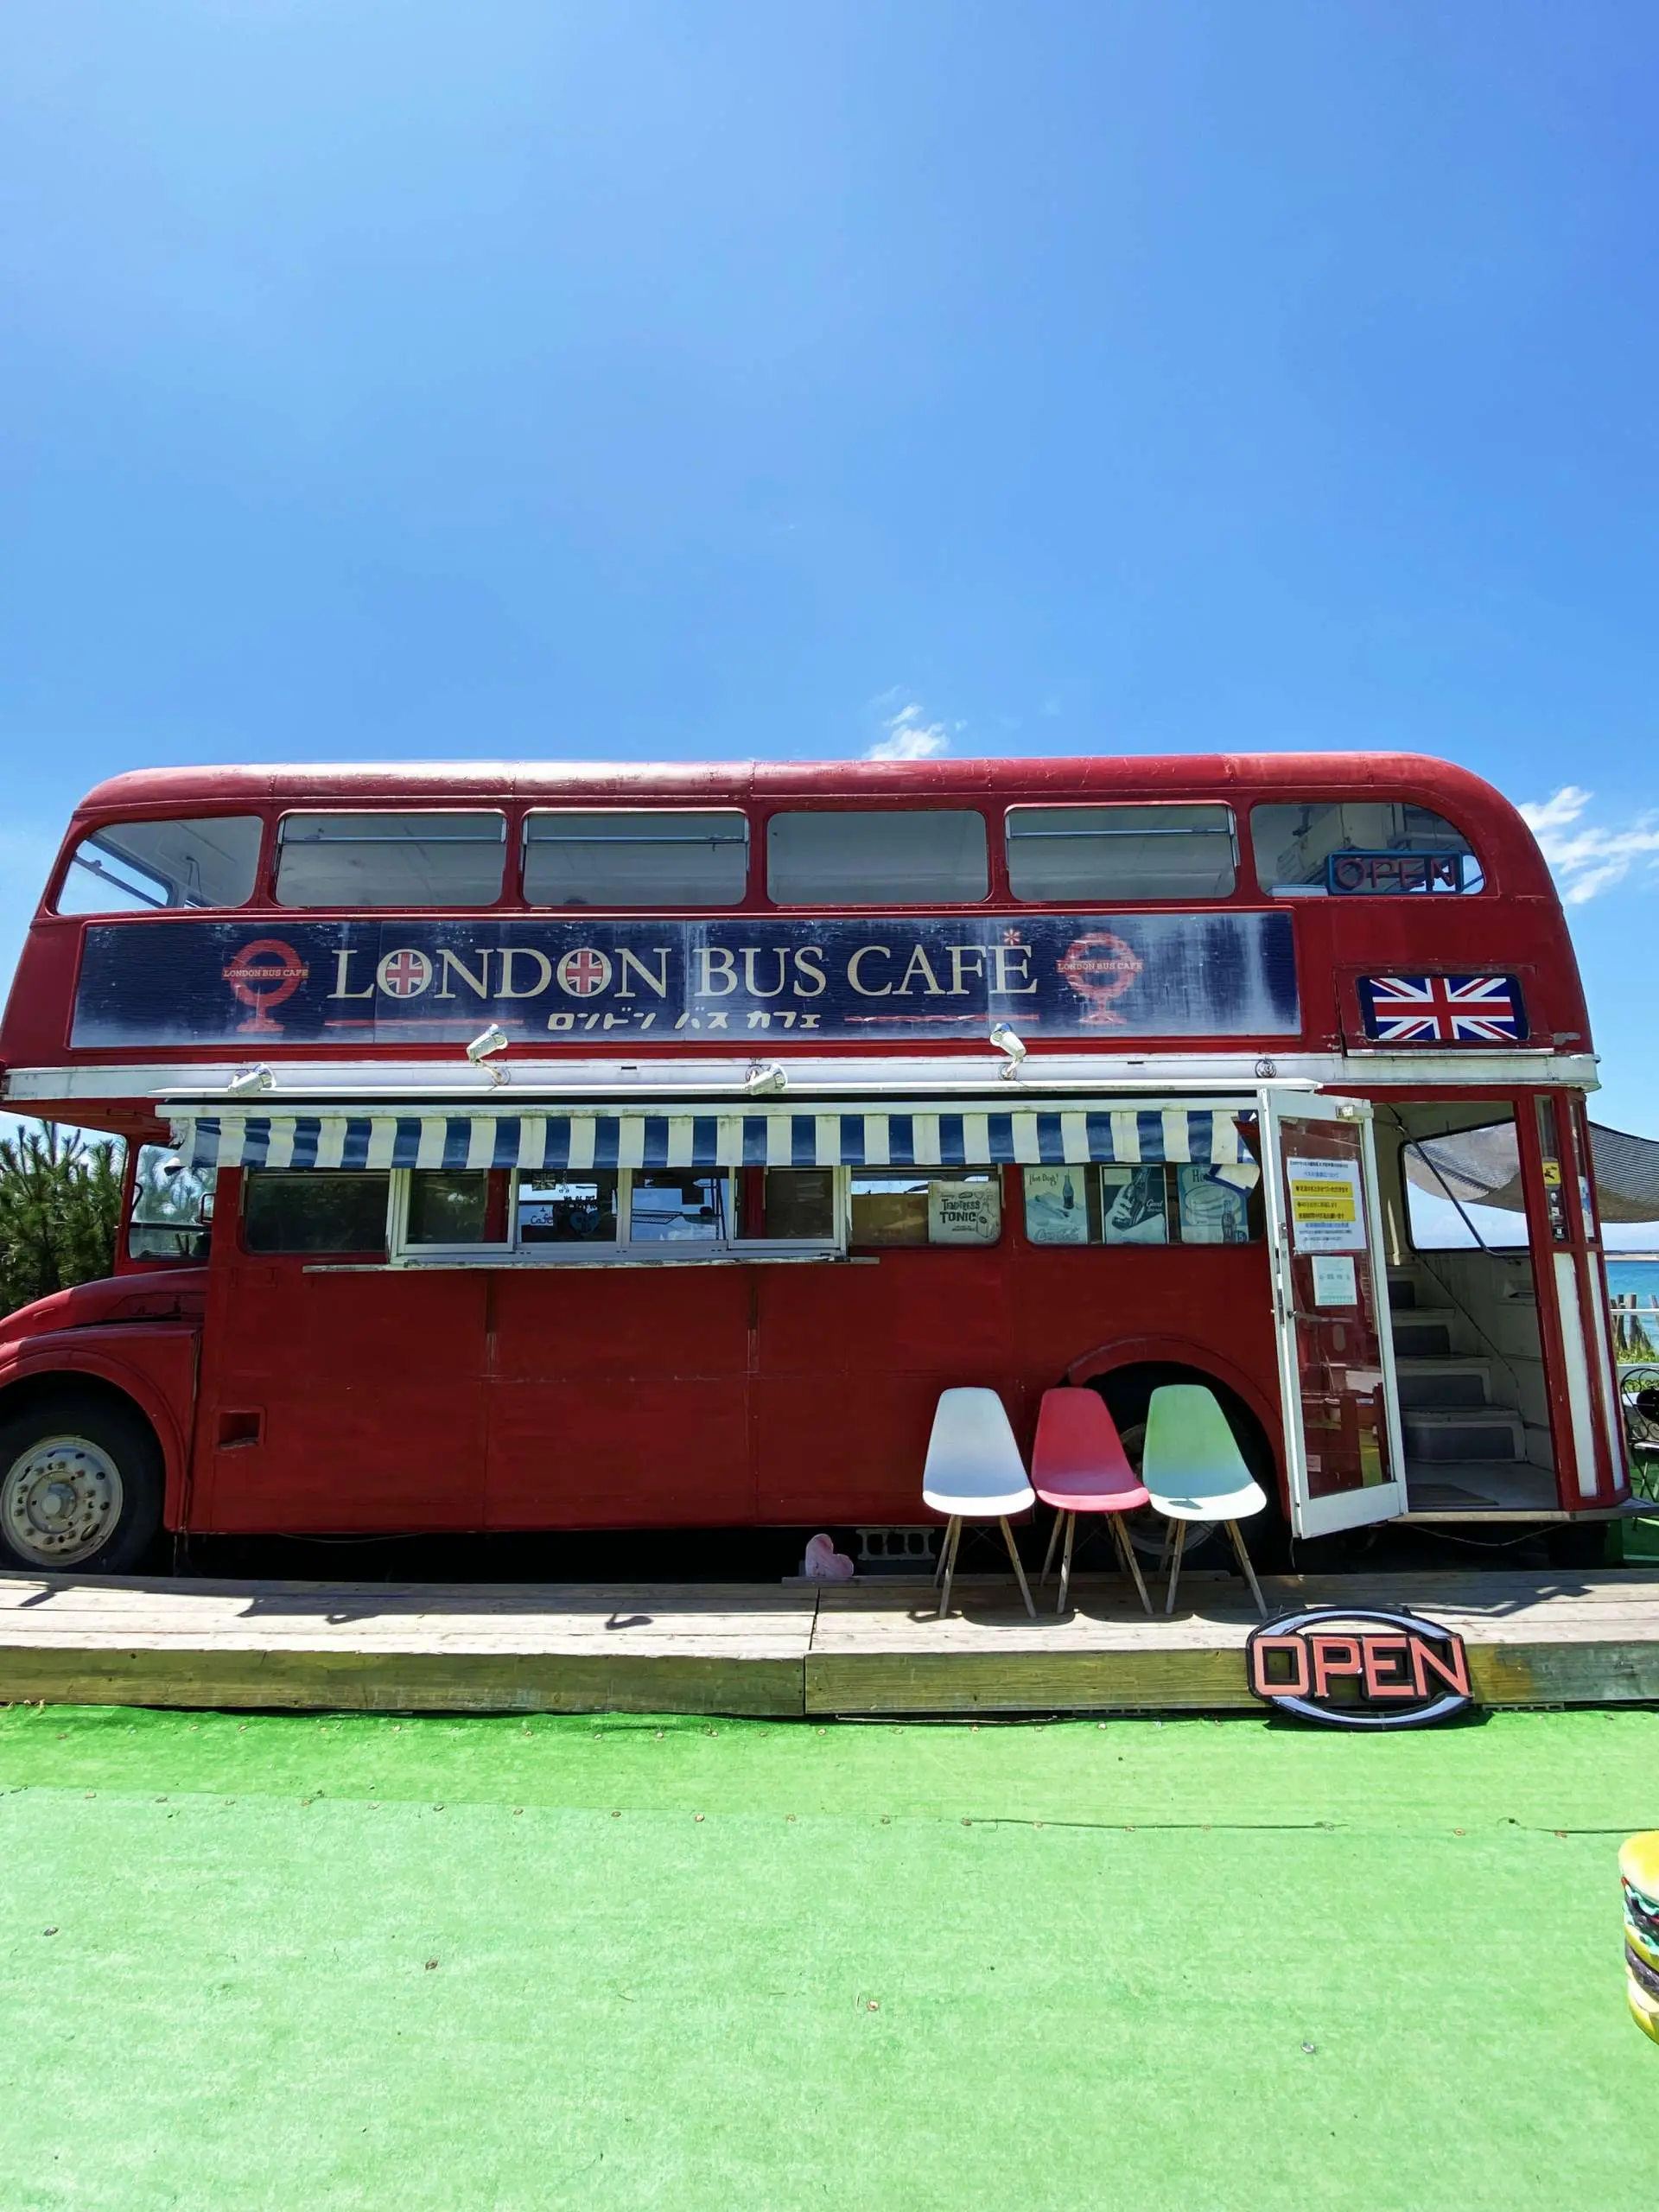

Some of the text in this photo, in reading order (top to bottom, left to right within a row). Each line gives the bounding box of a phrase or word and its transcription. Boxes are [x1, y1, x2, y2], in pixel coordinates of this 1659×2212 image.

[1336, 856, 1456, 890] OPEN
[223, 969, 260, 977] LONDON
[262, 969, 282, 977] BUS
[326, 947, 672, 1000] LONDON
[693, 946, 827, 998] BUS
[1057, 962, 1095, 970] LONDON
[547, 1006, 822, 1031] ロンドン バス カフェ
[939, 1211, 976, 1224] TONIC
[1253, 1635, 1471, 1697] OPEN
